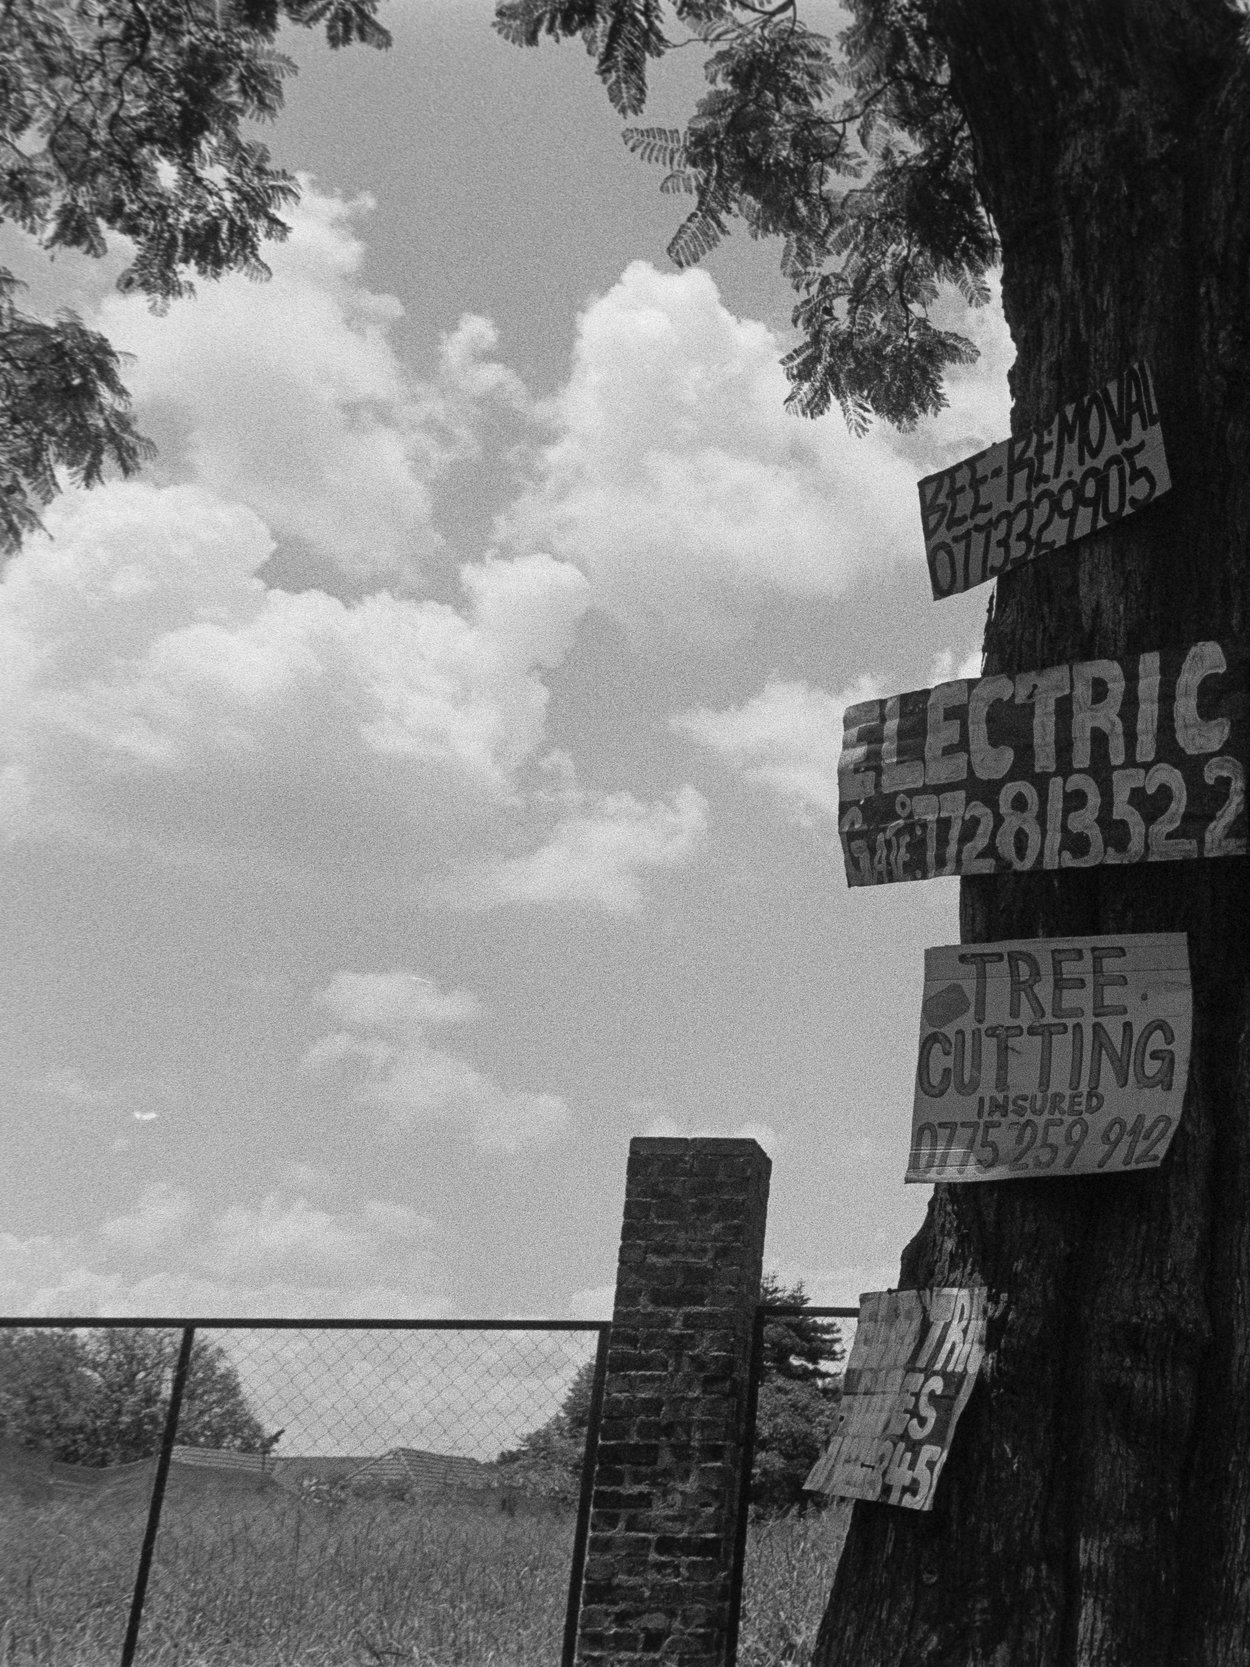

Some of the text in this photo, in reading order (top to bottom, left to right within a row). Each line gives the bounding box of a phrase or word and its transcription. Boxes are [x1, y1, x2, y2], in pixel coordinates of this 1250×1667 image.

[838, 641, 1231, 799] ELECTRIC
[958, 946, 1128, 1024] TREE
[918, 1019, 1175, 1098] CUTTING
[977, 1090, 1104, 1120] INSURED
[1098, 1113, 1172, 1168] 912
